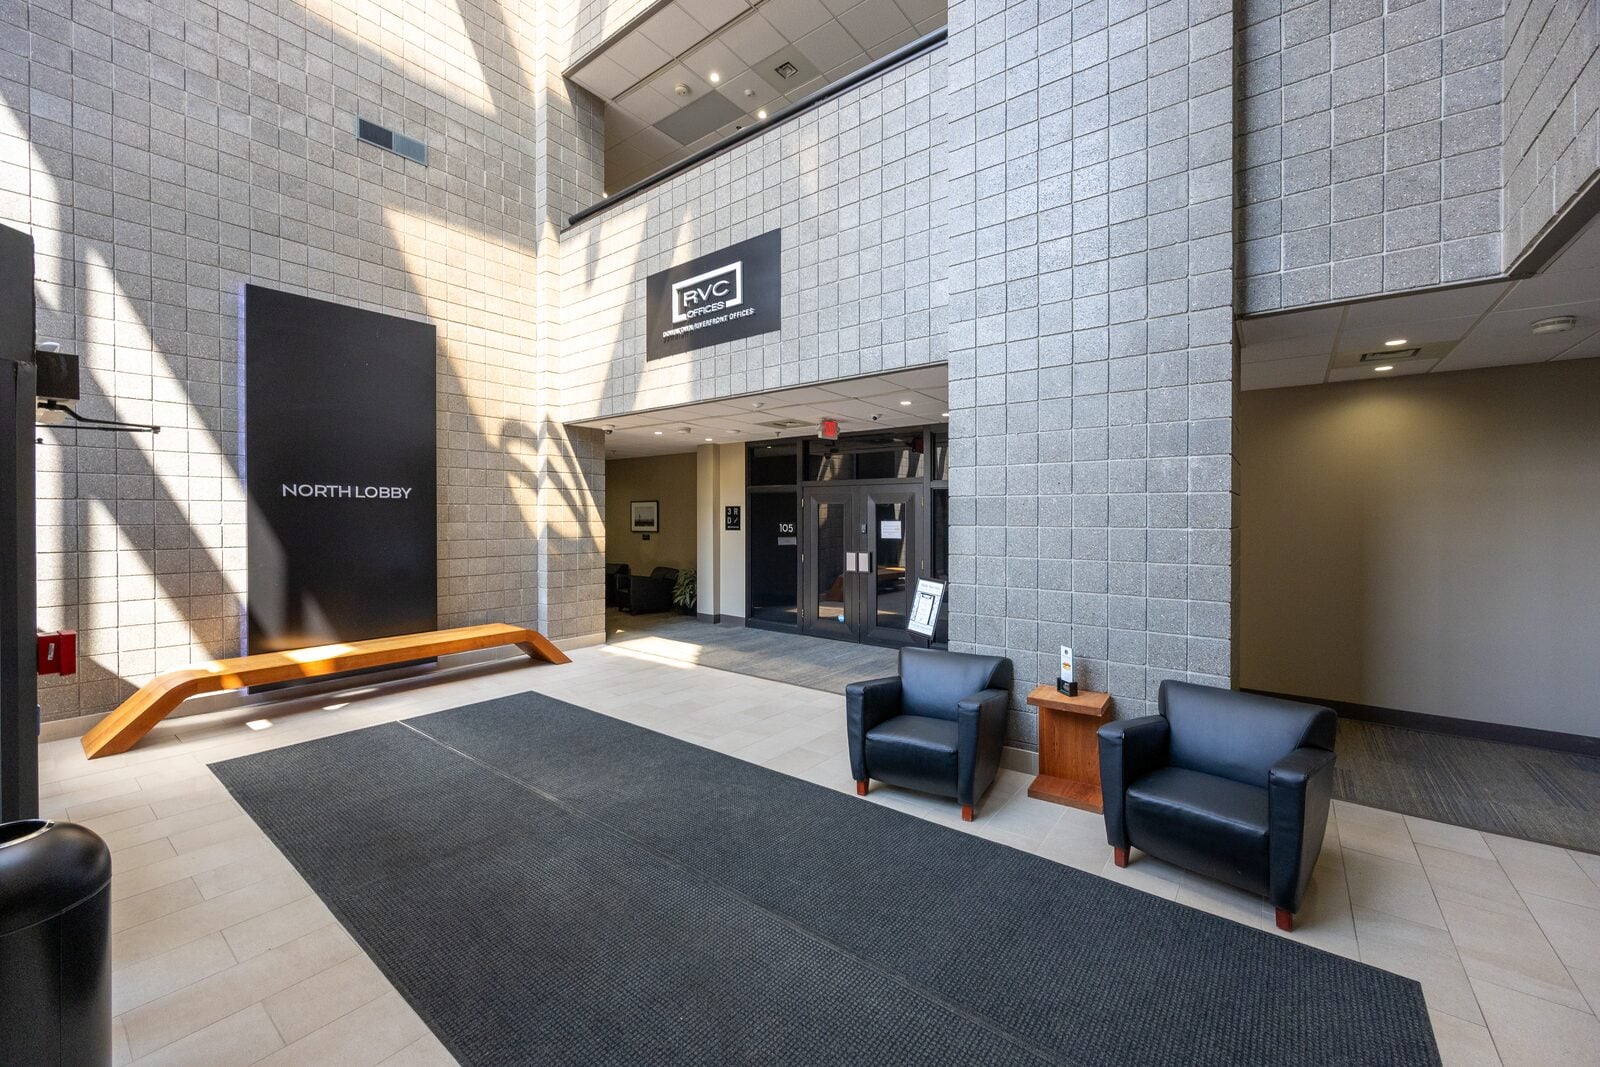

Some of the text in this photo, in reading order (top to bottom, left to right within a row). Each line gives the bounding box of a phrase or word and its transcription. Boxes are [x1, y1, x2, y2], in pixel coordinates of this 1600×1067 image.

[683, 280, 730, 307] RVC
[686, 301, 726, 319] OFFICES
[728, 307, 755, 320] OFFICES
[282, 483, 412, 499] NORTH LOBBY
[779, 523, 794, 533] 105
